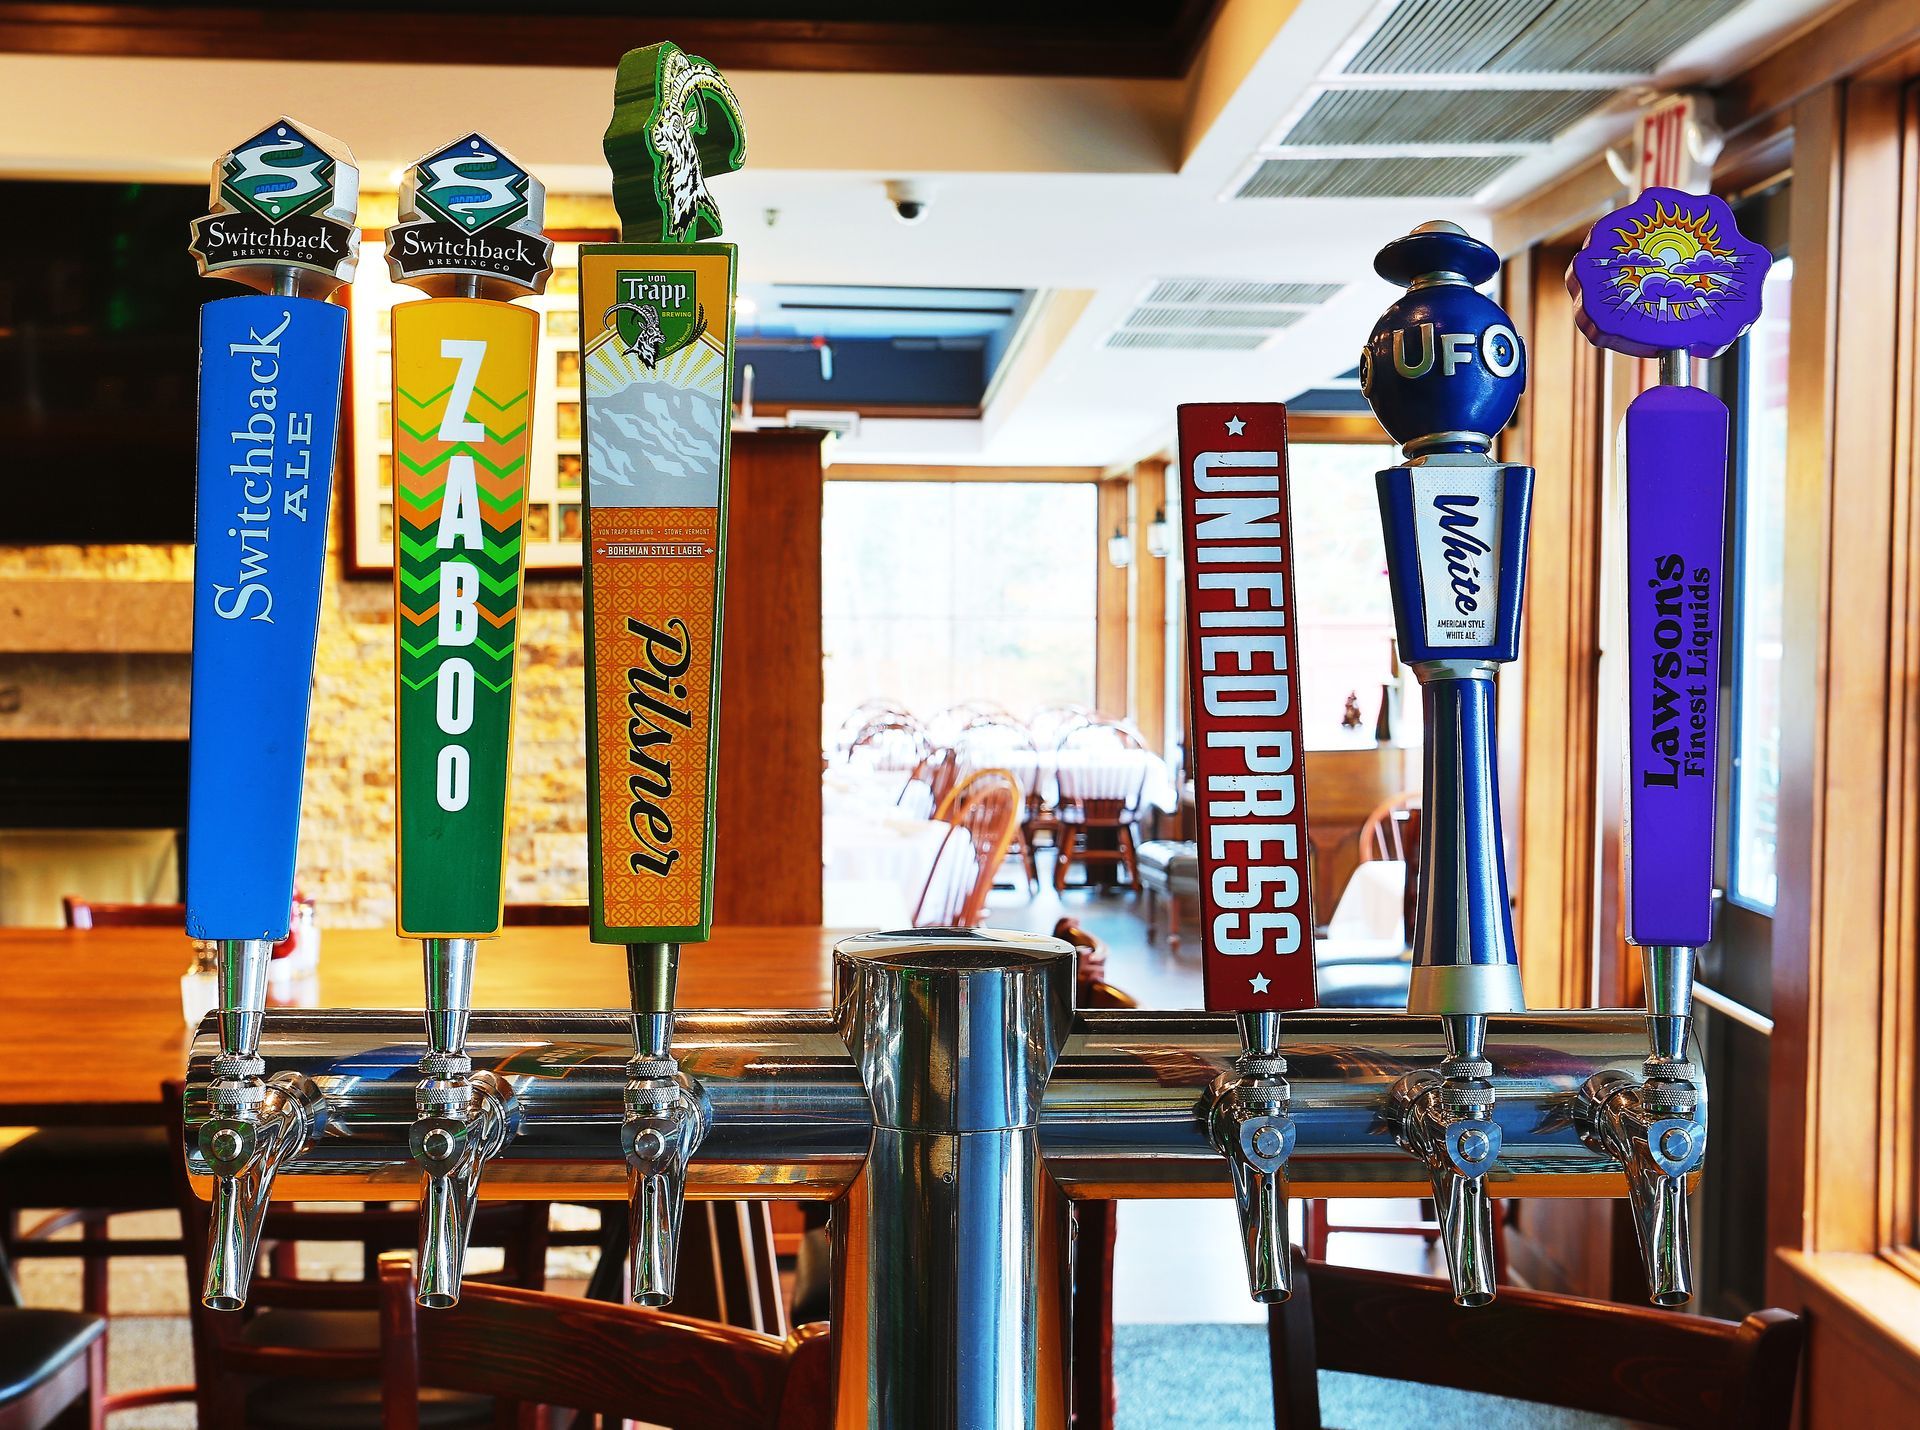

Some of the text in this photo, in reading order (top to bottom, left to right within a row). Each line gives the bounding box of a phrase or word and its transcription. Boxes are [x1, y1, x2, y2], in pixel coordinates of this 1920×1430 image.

[207, 221, 339, 253] Switchback
[232, 248, 290, 257] BREWING
[402, 230, 536, 266] Switchback
[428, 258, 510, 272] BREWING CO
[648, 275, 666, 283] von
[622, 278, 687, 308] Trapp
[1392, 322, 1520, 379] UFO
[212, 309, 293, 625] Switchback
[283, 411, 313, 522] ALE
[630, 528, 654, 536] BREWING
[685, 528, 710, 536] VERMONT
[608, 545, 702, 555] BOHEMIAN STYLE LAGER
[1432, 494, 1492, 616] White
[435, 339, 487, 813] ZABOO
[1437, 619, 1485, 628] AMERICAN STYLE
[1445, 631, 1476, 640] WHITE ALE
[1684, 567, 1713, 778] Finest Liquids
[1193, 451, 1302, 956] UNIFIED PRESS
[625, 617, 693, 877] Pilsner
